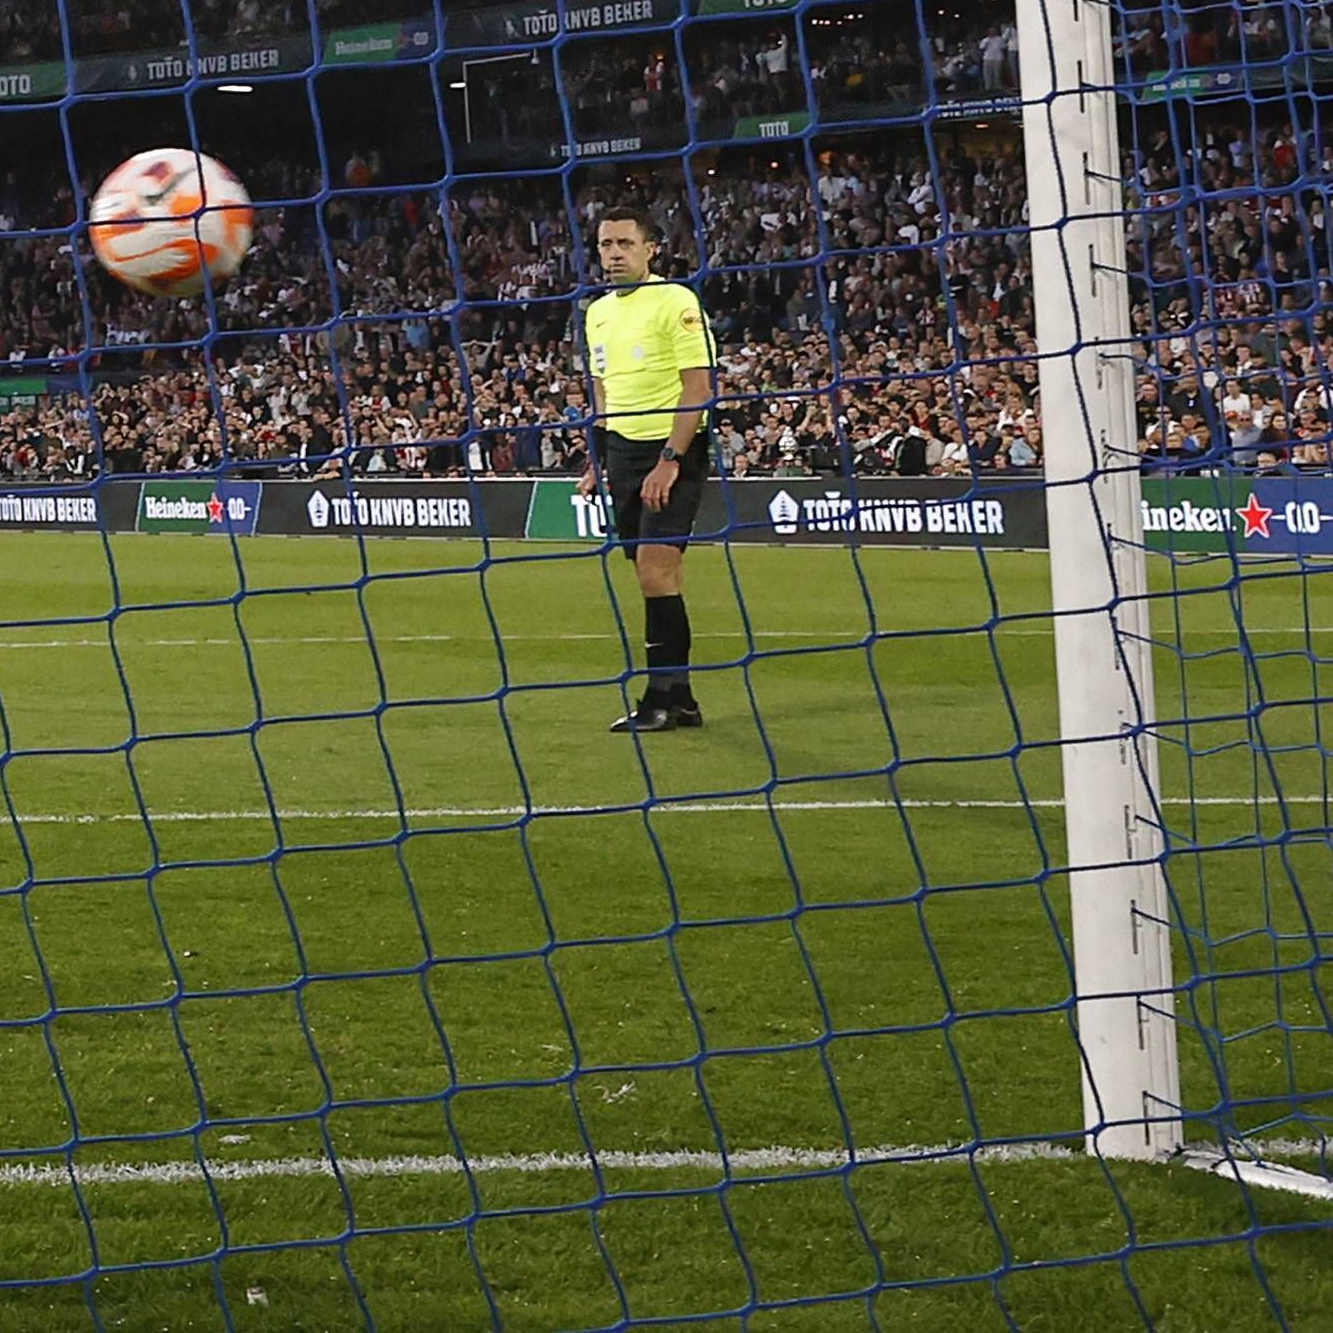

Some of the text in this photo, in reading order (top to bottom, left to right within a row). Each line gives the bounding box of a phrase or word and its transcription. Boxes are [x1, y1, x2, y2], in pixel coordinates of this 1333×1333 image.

[523, 10, 558, 35] TOTO
[604, 0, 653, 25] BEKER
[147, 56, 183, 80] TOTO
[231, 50, 279, 71] BEKER
[761, 121, 791, 138] TOTO
[611, 137, 642, 153] BEKER
[22, 498, 55, 521] KNVB
[57, 497, 98, 522] BEKER
[145, 496, 208, 519] Heineken
[331, 491, 472, 527] TOO KNVB BEKER
[571, 495, 613, 537] TO
[802, 491, 1005, 534] TOTO KNVB BEKER
